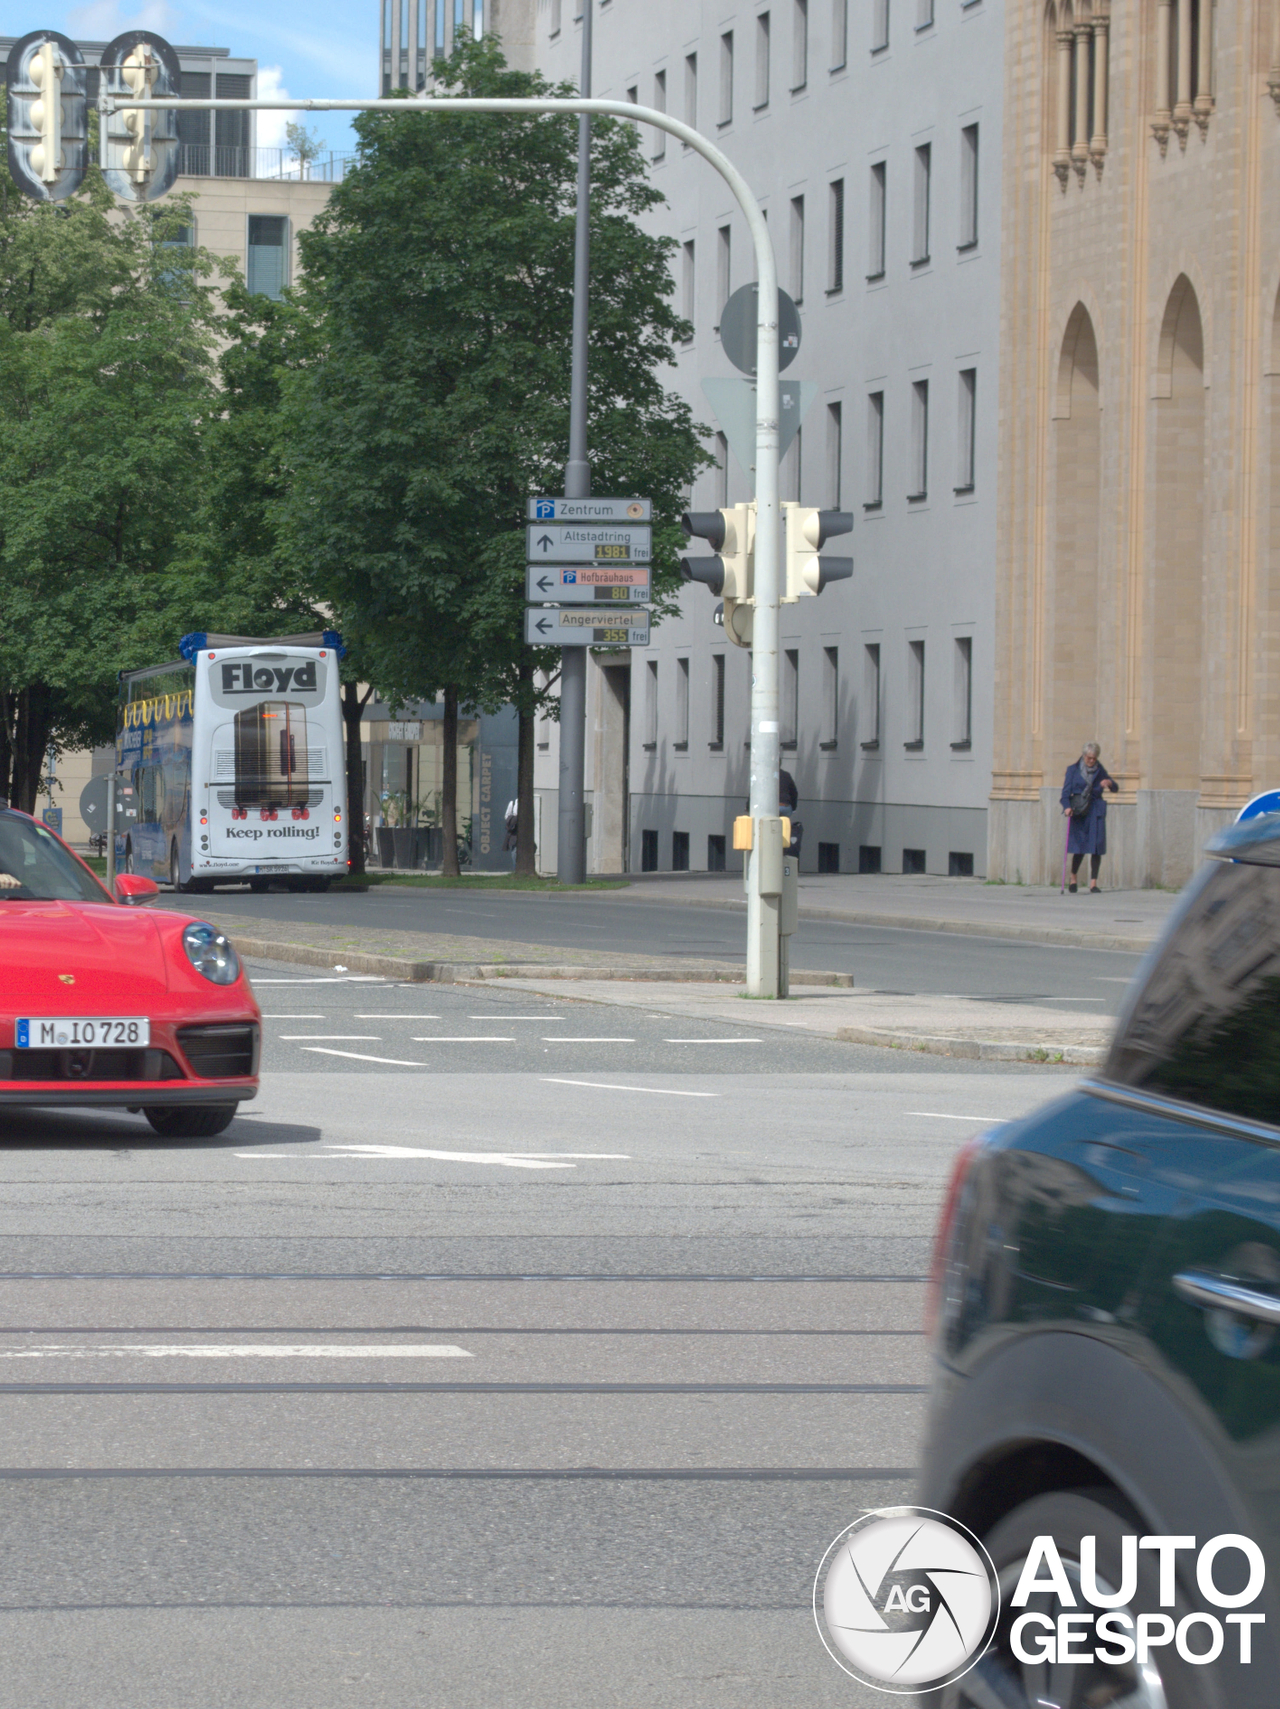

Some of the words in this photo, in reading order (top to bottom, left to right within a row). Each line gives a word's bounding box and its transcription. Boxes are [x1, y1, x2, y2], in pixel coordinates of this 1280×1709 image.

[560, 504, 613, 515] Zentrum
[564, 531, 631, 544] Altstadtring
[596, 545, 628, 558] 1981
[634, 547, 649, 558] frei
[580, 572, 634, 583] Hofbräuhaus
[611, 586, 628, 599] 80
[633, 588, 648, 599] frei
[562, 614, 634, 626] Angerviertel
[603, 629, 627, 642] 355
[632, 631, 647, 641] frei
[221, 661, 317, 693] Floyd
[481, 753, 492, 802] CARPET
[226, 827, 263, 841] Keep
[267, 826, 320, 841] rolling!
[480, 807, 491, 854] OBJECT
[41, 1023, 55, 1044] M
[100, 1022, 139, 1043] 728
